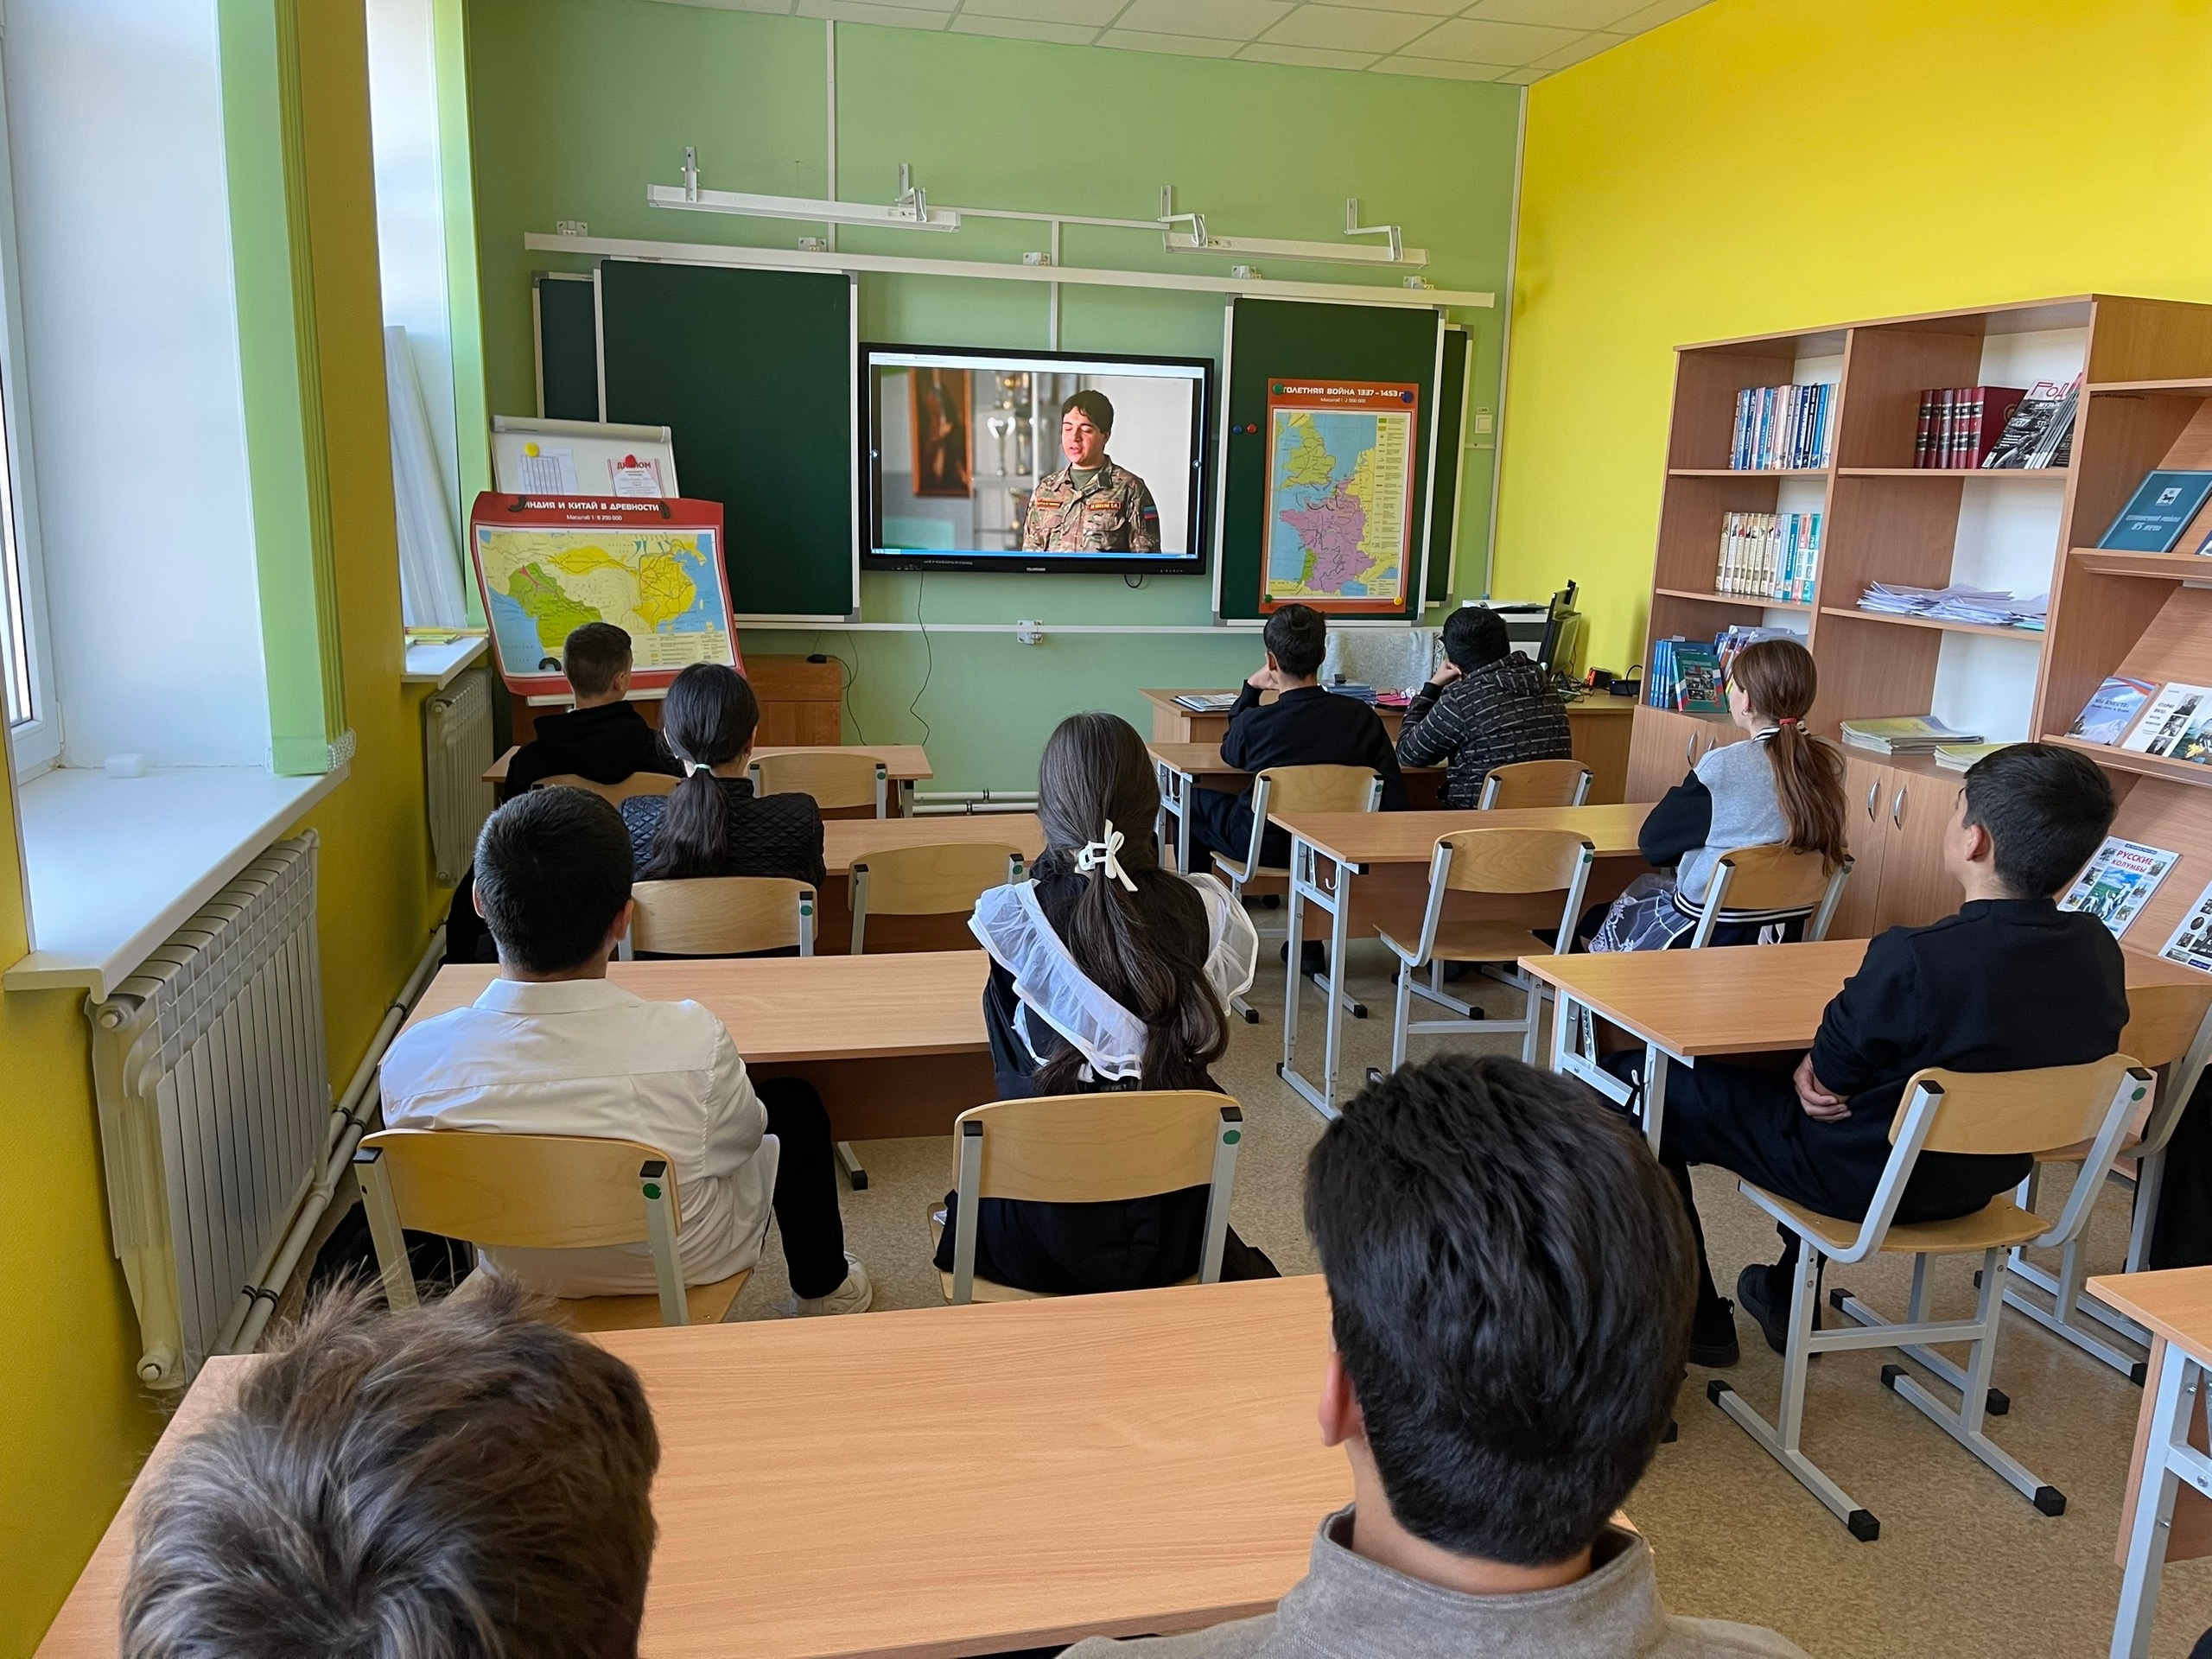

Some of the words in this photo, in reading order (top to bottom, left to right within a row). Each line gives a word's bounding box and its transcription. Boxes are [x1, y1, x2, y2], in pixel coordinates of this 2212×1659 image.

[1282, 386, 1324, 395] ТОЛЕТНЯЯ
[1327, 387, 1355, 396] ВОЙНА
[617, 461, 652, 470] ДЛОМ
[524, 501, 556, 510] ИНДИЯ
[569, 500, 598, 511] КИТАЙ
[601, 502, 607, 511] В
[609, 503, 659, 512] ДРЕВНОСТИ
[2116, 850, 2155, 865] РУССКИЕ
[2111, 859, 2147, 873] КОЛУМБЫ
